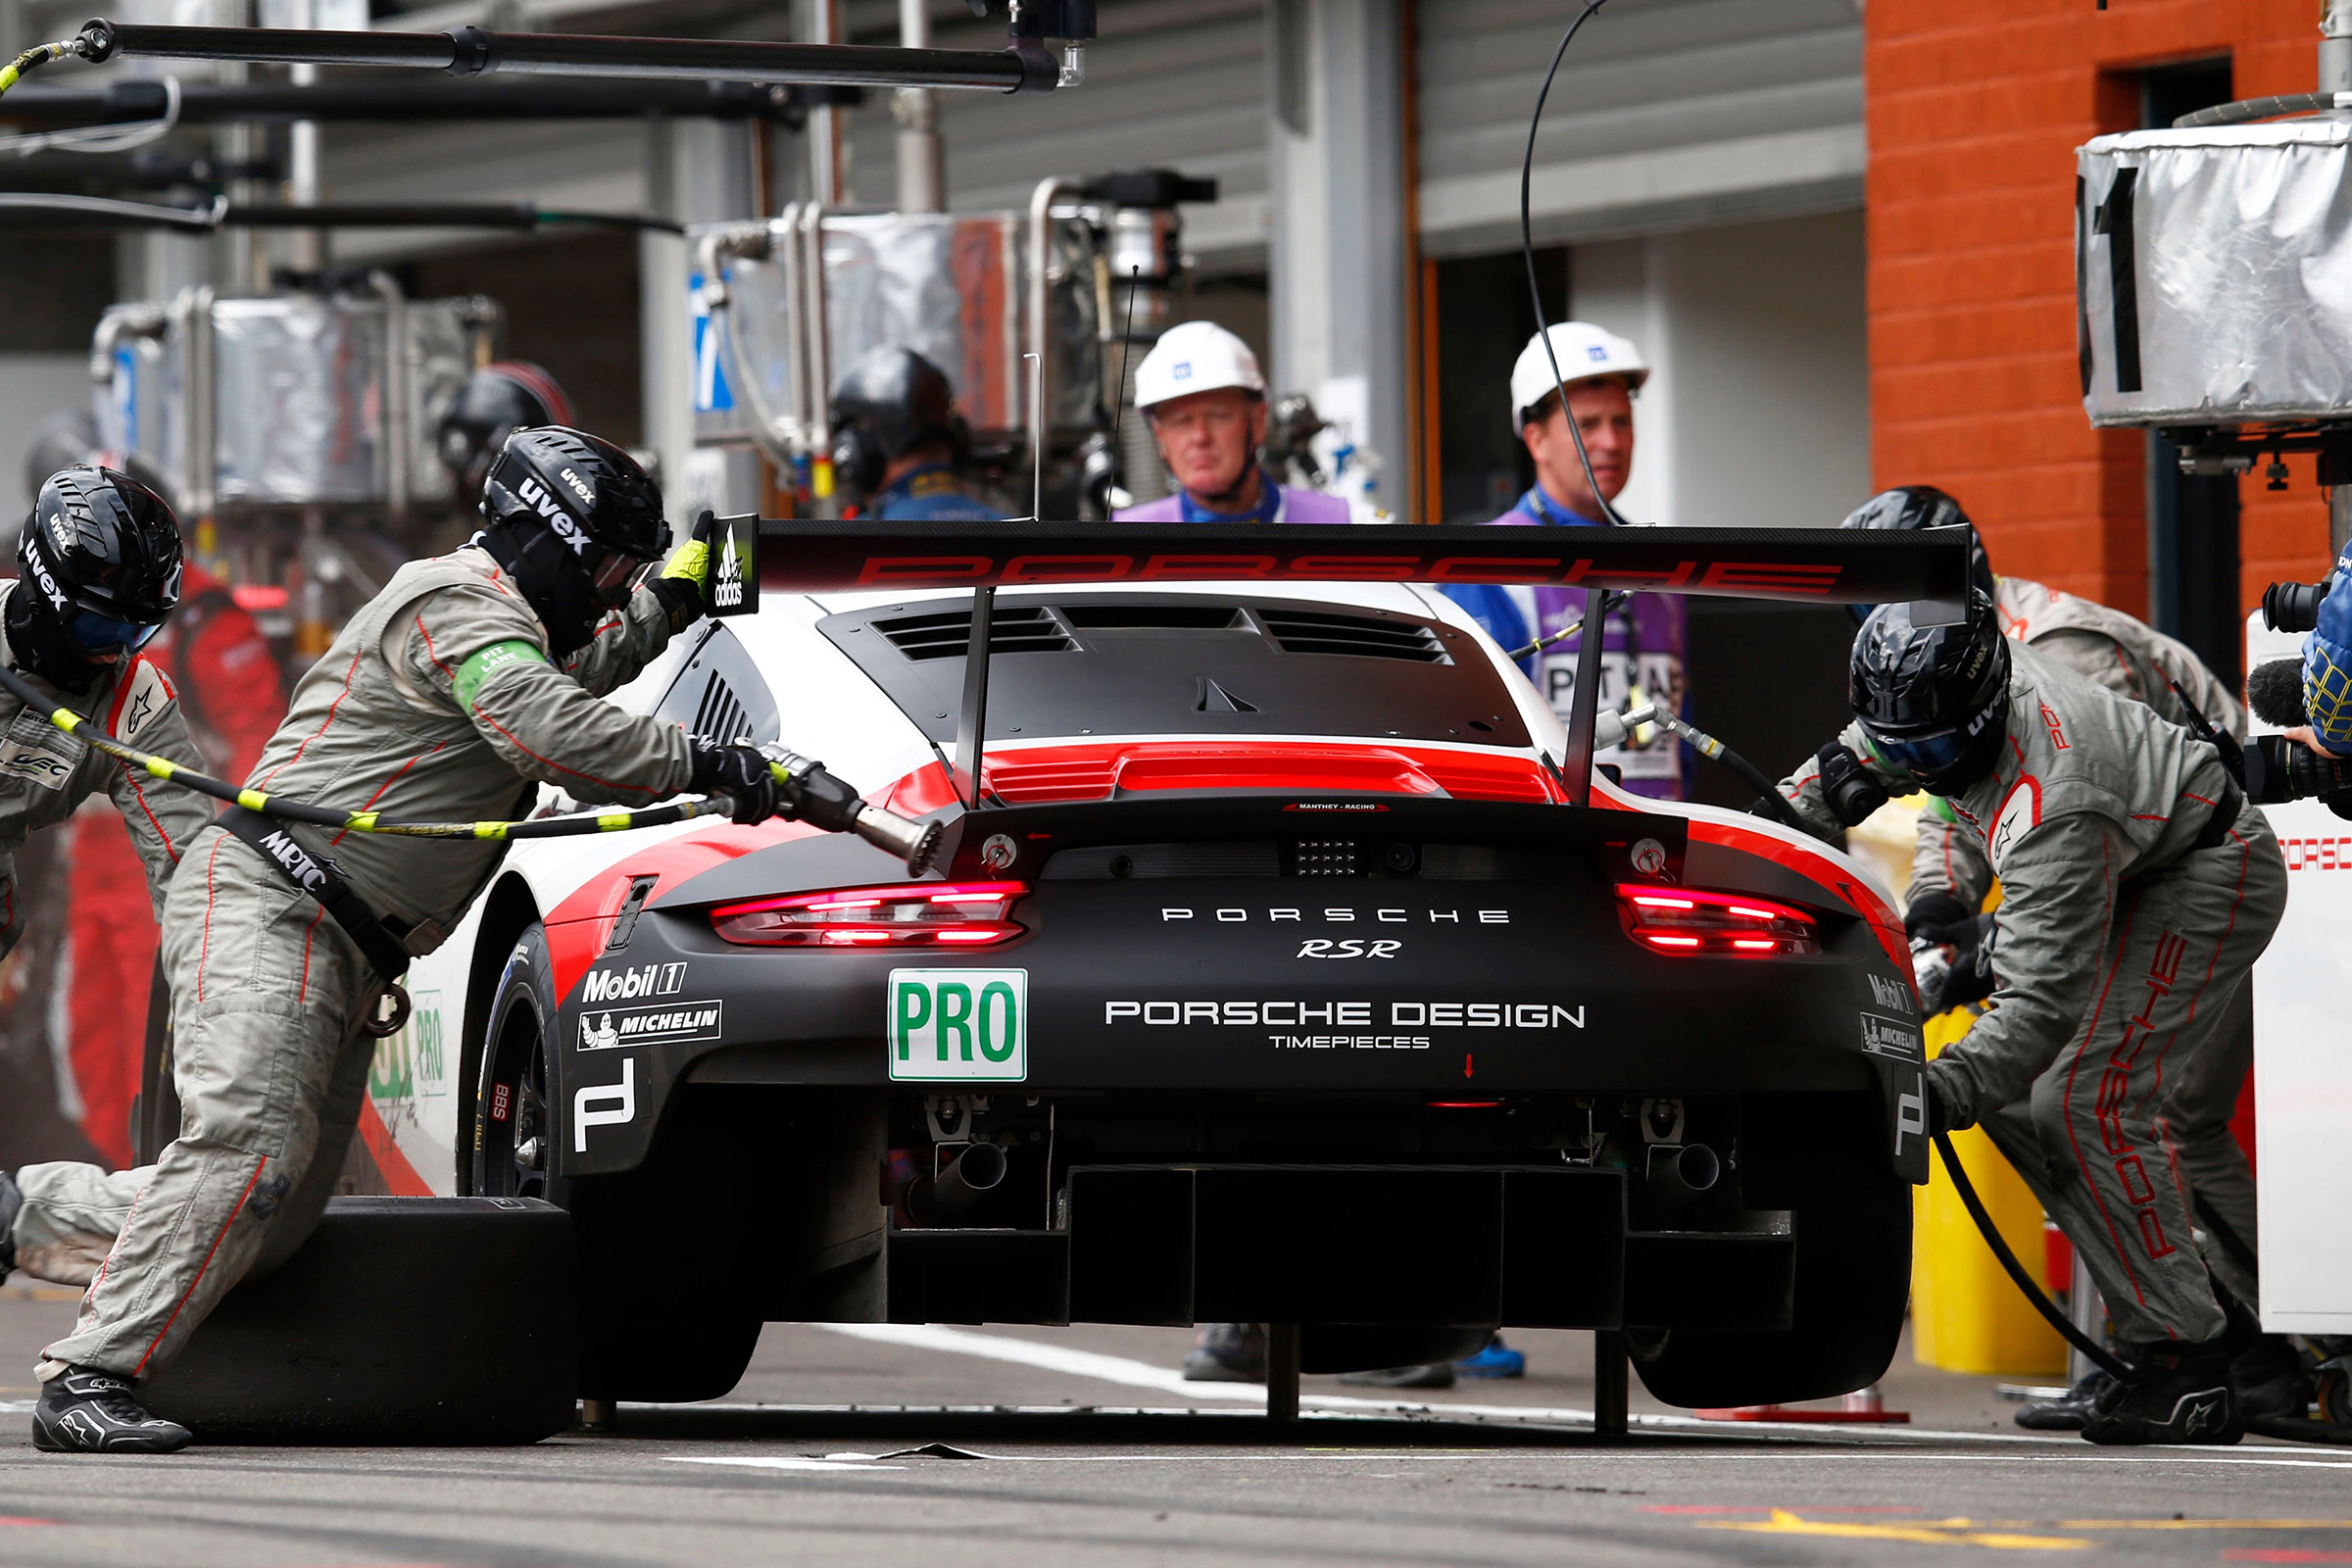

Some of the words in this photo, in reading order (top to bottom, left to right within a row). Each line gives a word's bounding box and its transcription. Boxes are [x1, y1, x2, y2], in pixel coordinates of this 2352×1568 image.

[560, 467, 596, 505] uvex
[49, 513, 72, 551] uvex
[517, 477, 592, 556] uvex
[25, 538, 69, 612] uvex
[715, 578, 743, 607] adidas
[854, 555, 1842, 594] PORSCHE
[480, 647, 504, 661] PIT
[480, 652, 518, 673] LANE
[1966, 643, 1988, 680] uvex
[258, 830, 326, 892] MRTC
[1161, 907, 1510, 924] PORSCHE
[1296, 938, 1403, 959] RSR
[581, 964, 659, 1003] Mobil
[1867, 973, 1904, 1011] Mobil
[618, 1009, 718, 1034] MICHELIN
[898, 980, 1016, 1063] PRO
[1105, 1001, 1372, 1026] PORSCHE
[1392, 1002, 1585, 1029] DESIGN
[416, 1007, 443, 1081] PRO
[1268, 1035, 1430, 1049] TIMEPIECES
[1880, 1026, 1918, 1051] MICHELIN
[493, 1084, 509, 1120] BBS
[2094, 930, 2188, 1260] PORSCHE
